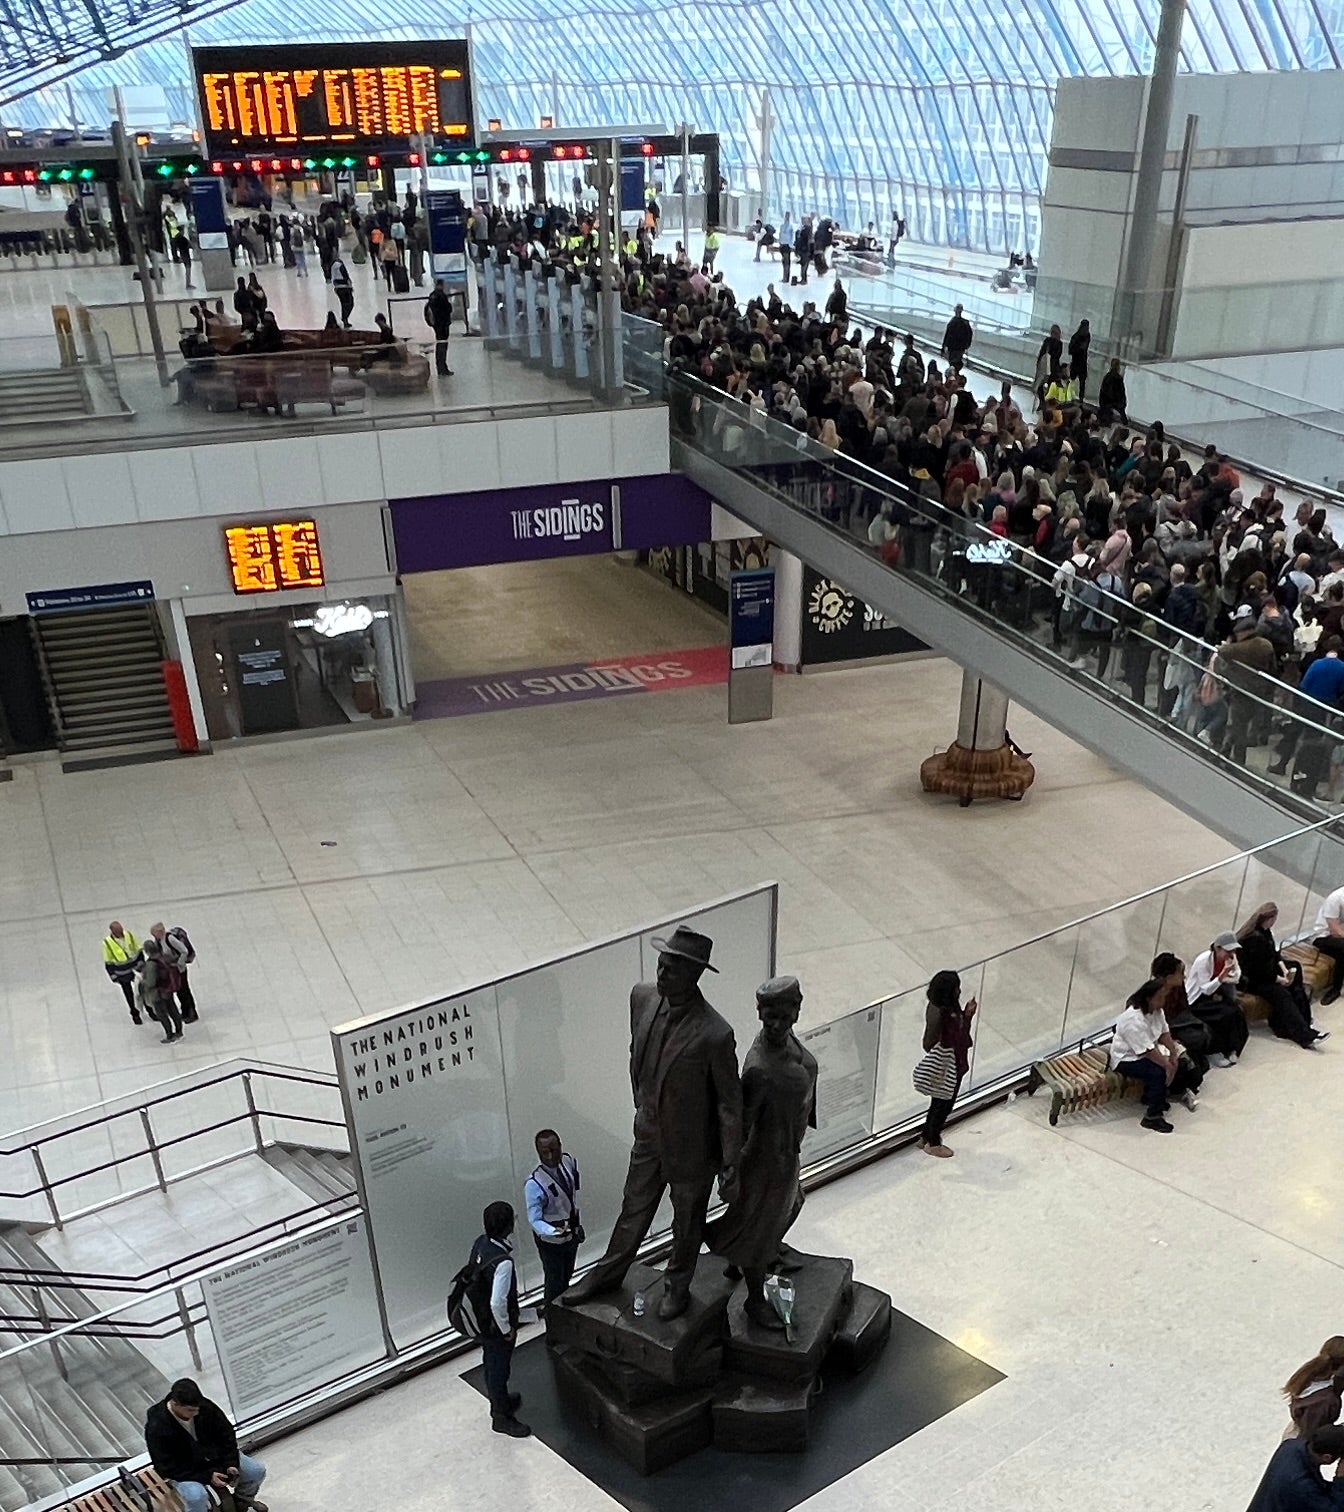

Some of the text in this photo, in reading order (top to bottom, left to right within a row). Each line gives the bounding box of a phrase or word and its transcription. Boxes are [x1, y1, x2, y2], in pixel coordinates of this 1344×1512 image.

[510, 499, 604, 540] THE SIDINGS
[467, 661, 693, 703] THE SIDINGS
[350, 1004, 471, 1057] THE NATIONAL
[354, 1025, 474, 1078] WINDRUSH
[357, 1047, 475, 1101] MONUMENT
